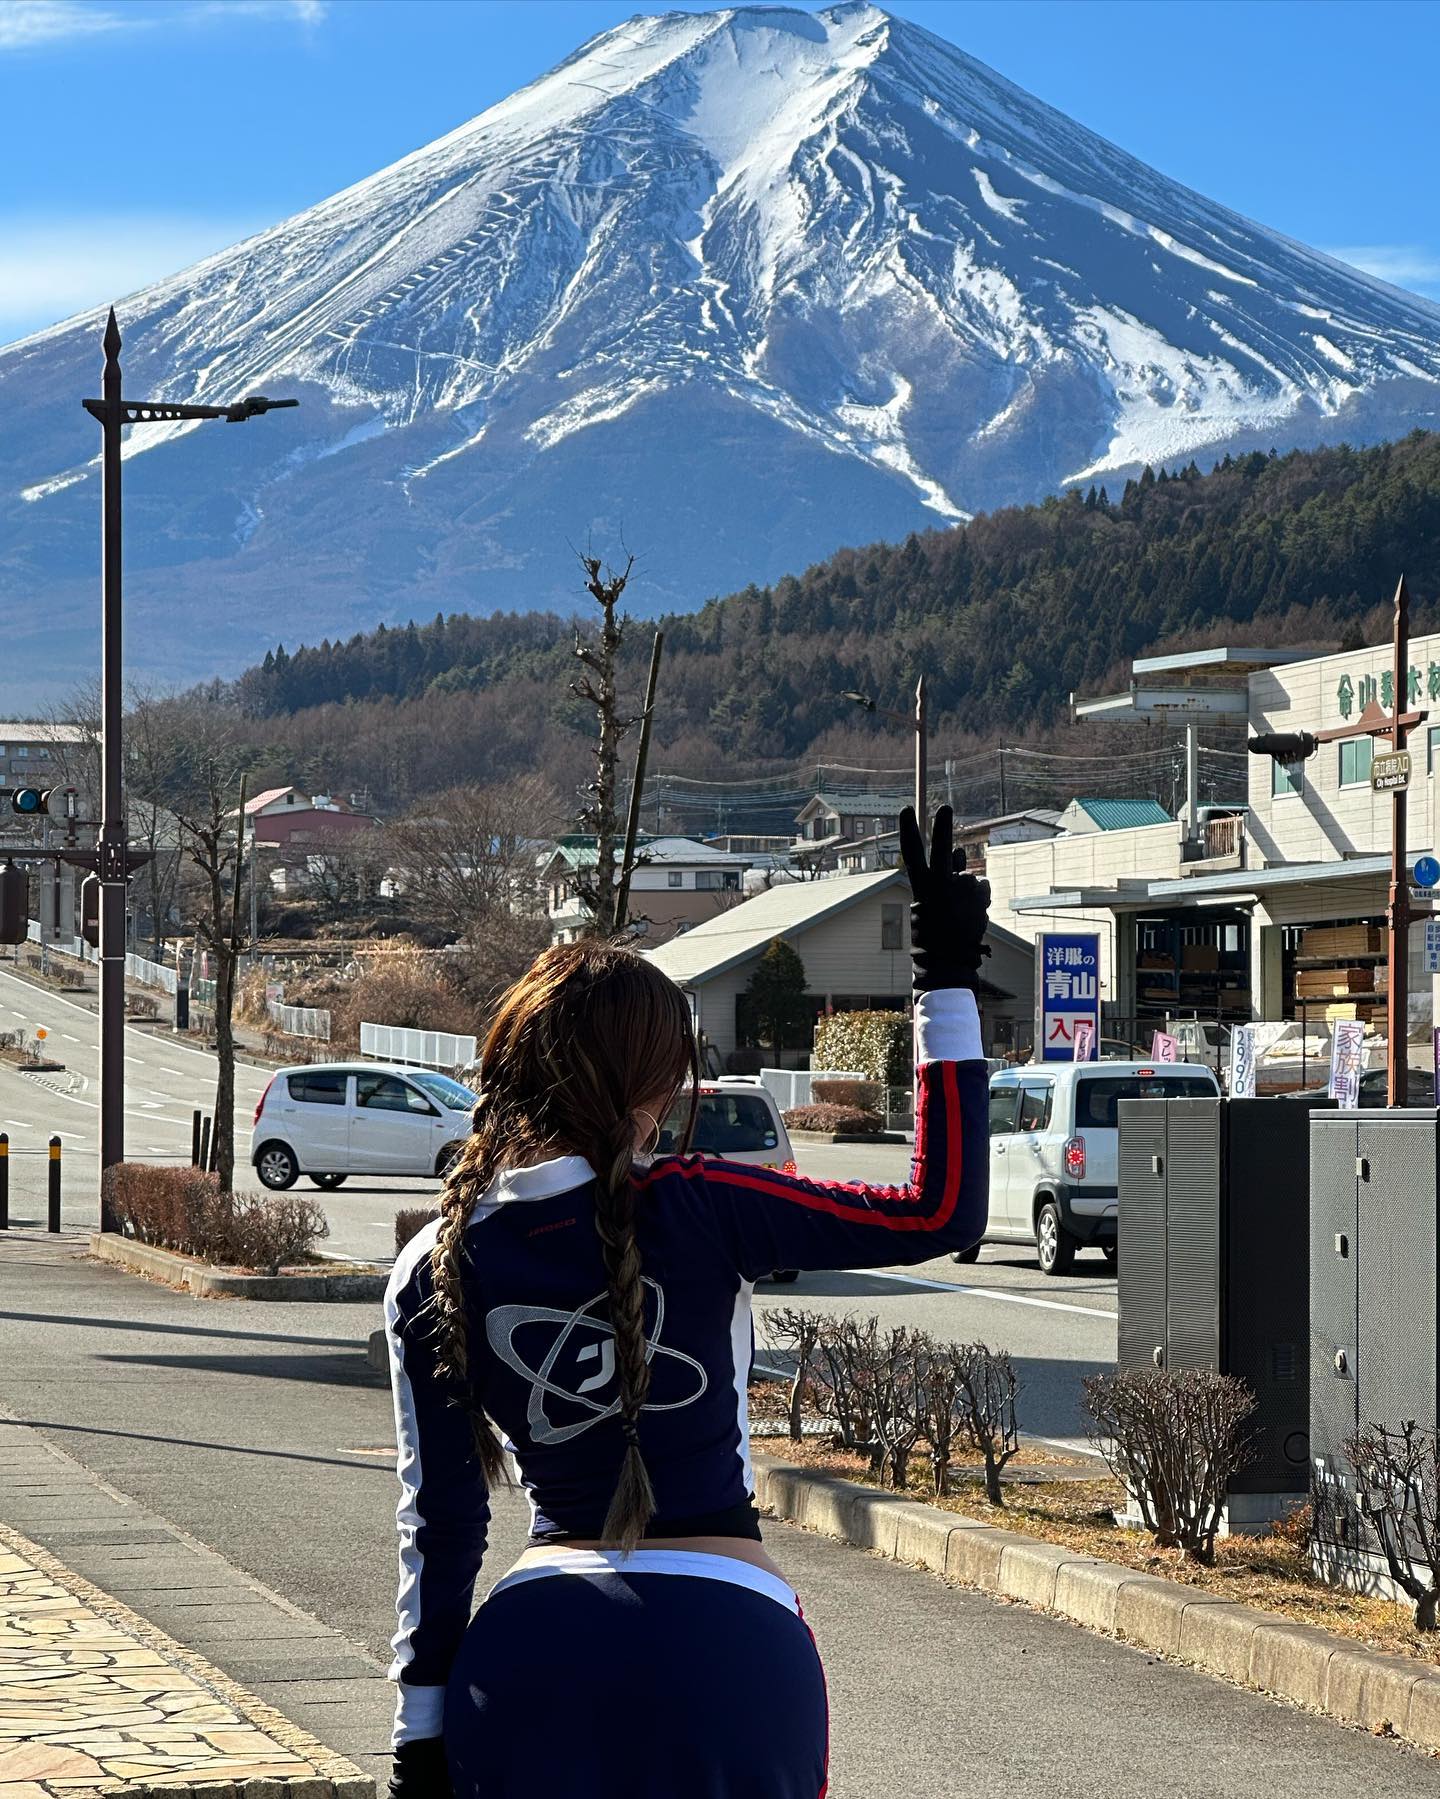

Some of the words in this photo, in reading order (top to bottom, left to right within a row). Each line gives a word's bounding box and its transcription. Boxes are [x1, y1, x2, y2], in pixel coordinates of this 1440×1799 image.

[1047, 947, 1095, 965] 洋服の
[1046, 970, 1096, 999] 青山
[1334, 1024, 1362, 1102] 家族割
